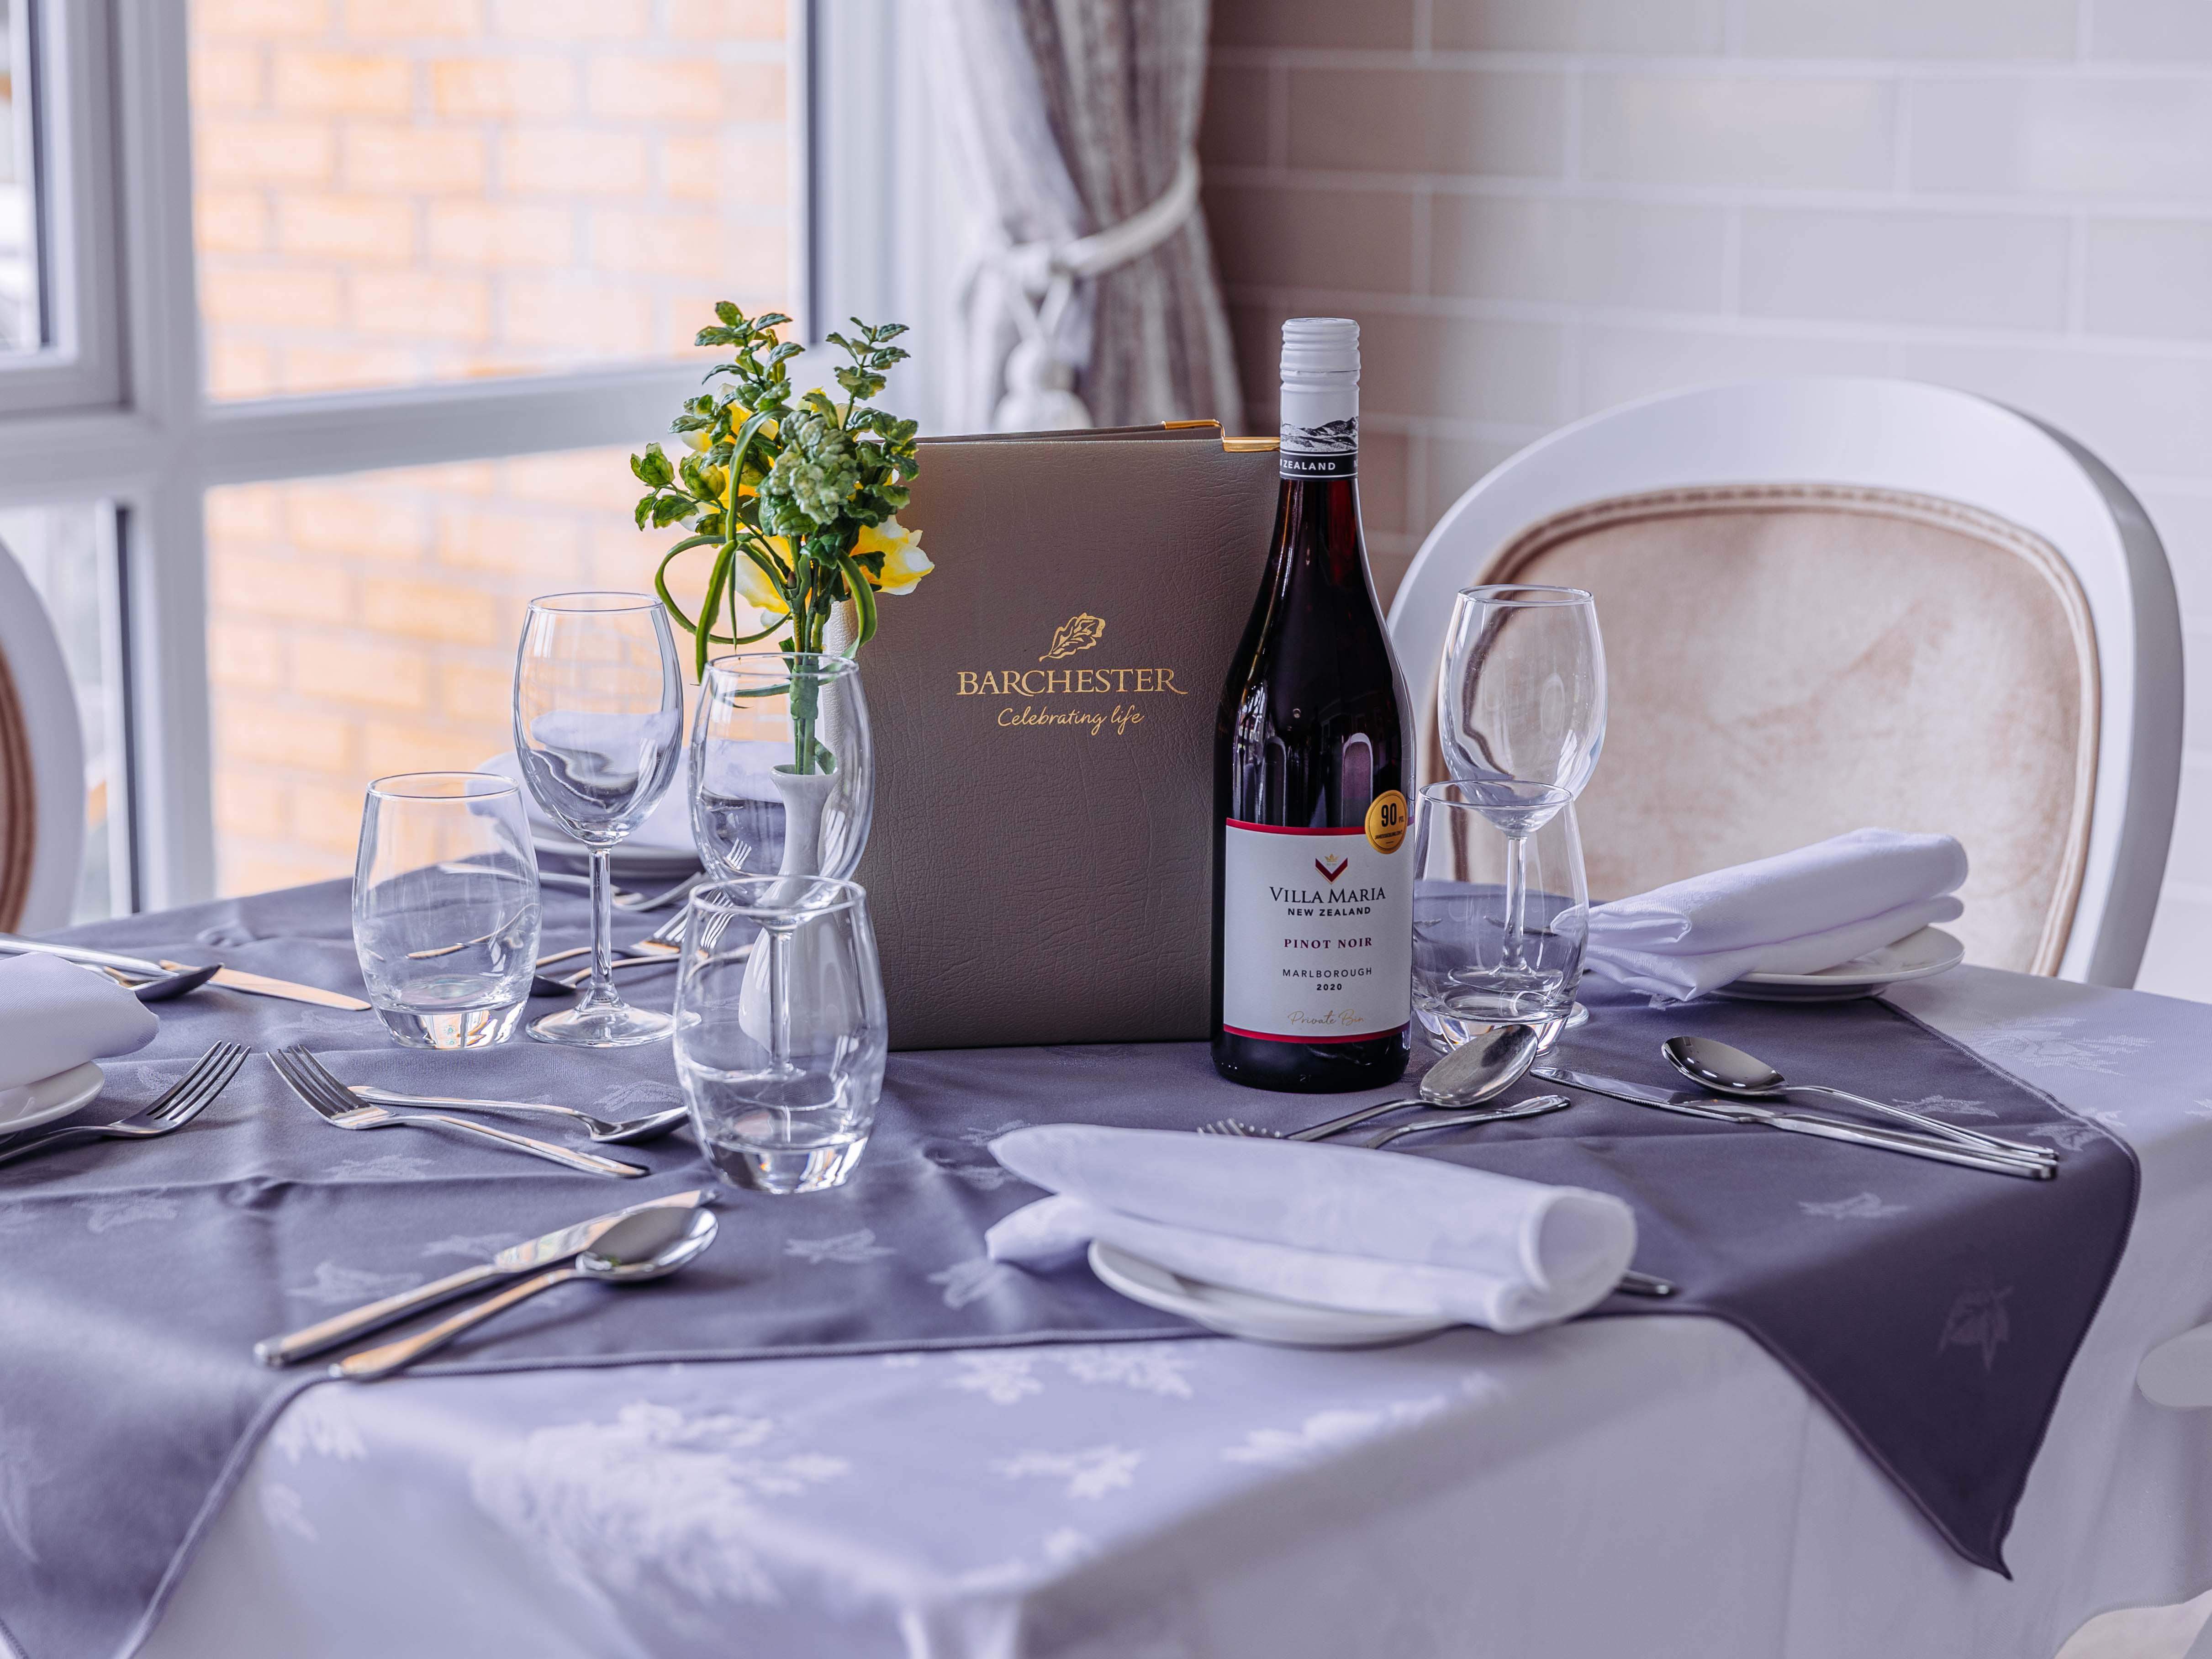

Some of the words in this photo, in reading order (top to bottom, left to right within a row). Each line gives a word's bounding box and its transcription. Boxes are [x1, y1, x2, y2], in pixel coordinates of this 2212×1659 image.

[1283, 460, 1336, 470] ZEALAND
[956, 668, 1188, 697] BARCHESTER
[998, 706, 1107, 736] Celebrating
[1111, 704, 1145, 735] life
[1381, 803, 1397, 827] 90
[1269, 886, 1324, 903] VILLA
[1327, 887, 1386, 903] MARIA
[1288, 908, 1314, 916] NEW
[1319, 907, 1371, 916] ZEALAND
[1284, 939, 1331, 949] PINOT
[1338, 937, 1373, 949] NOIR
[1283, 967, 1372, 978] MARLBOROUGH
[1287, 1010, 1337, 1025] Private
[1338, 1009, 1365, 1026] Bin
